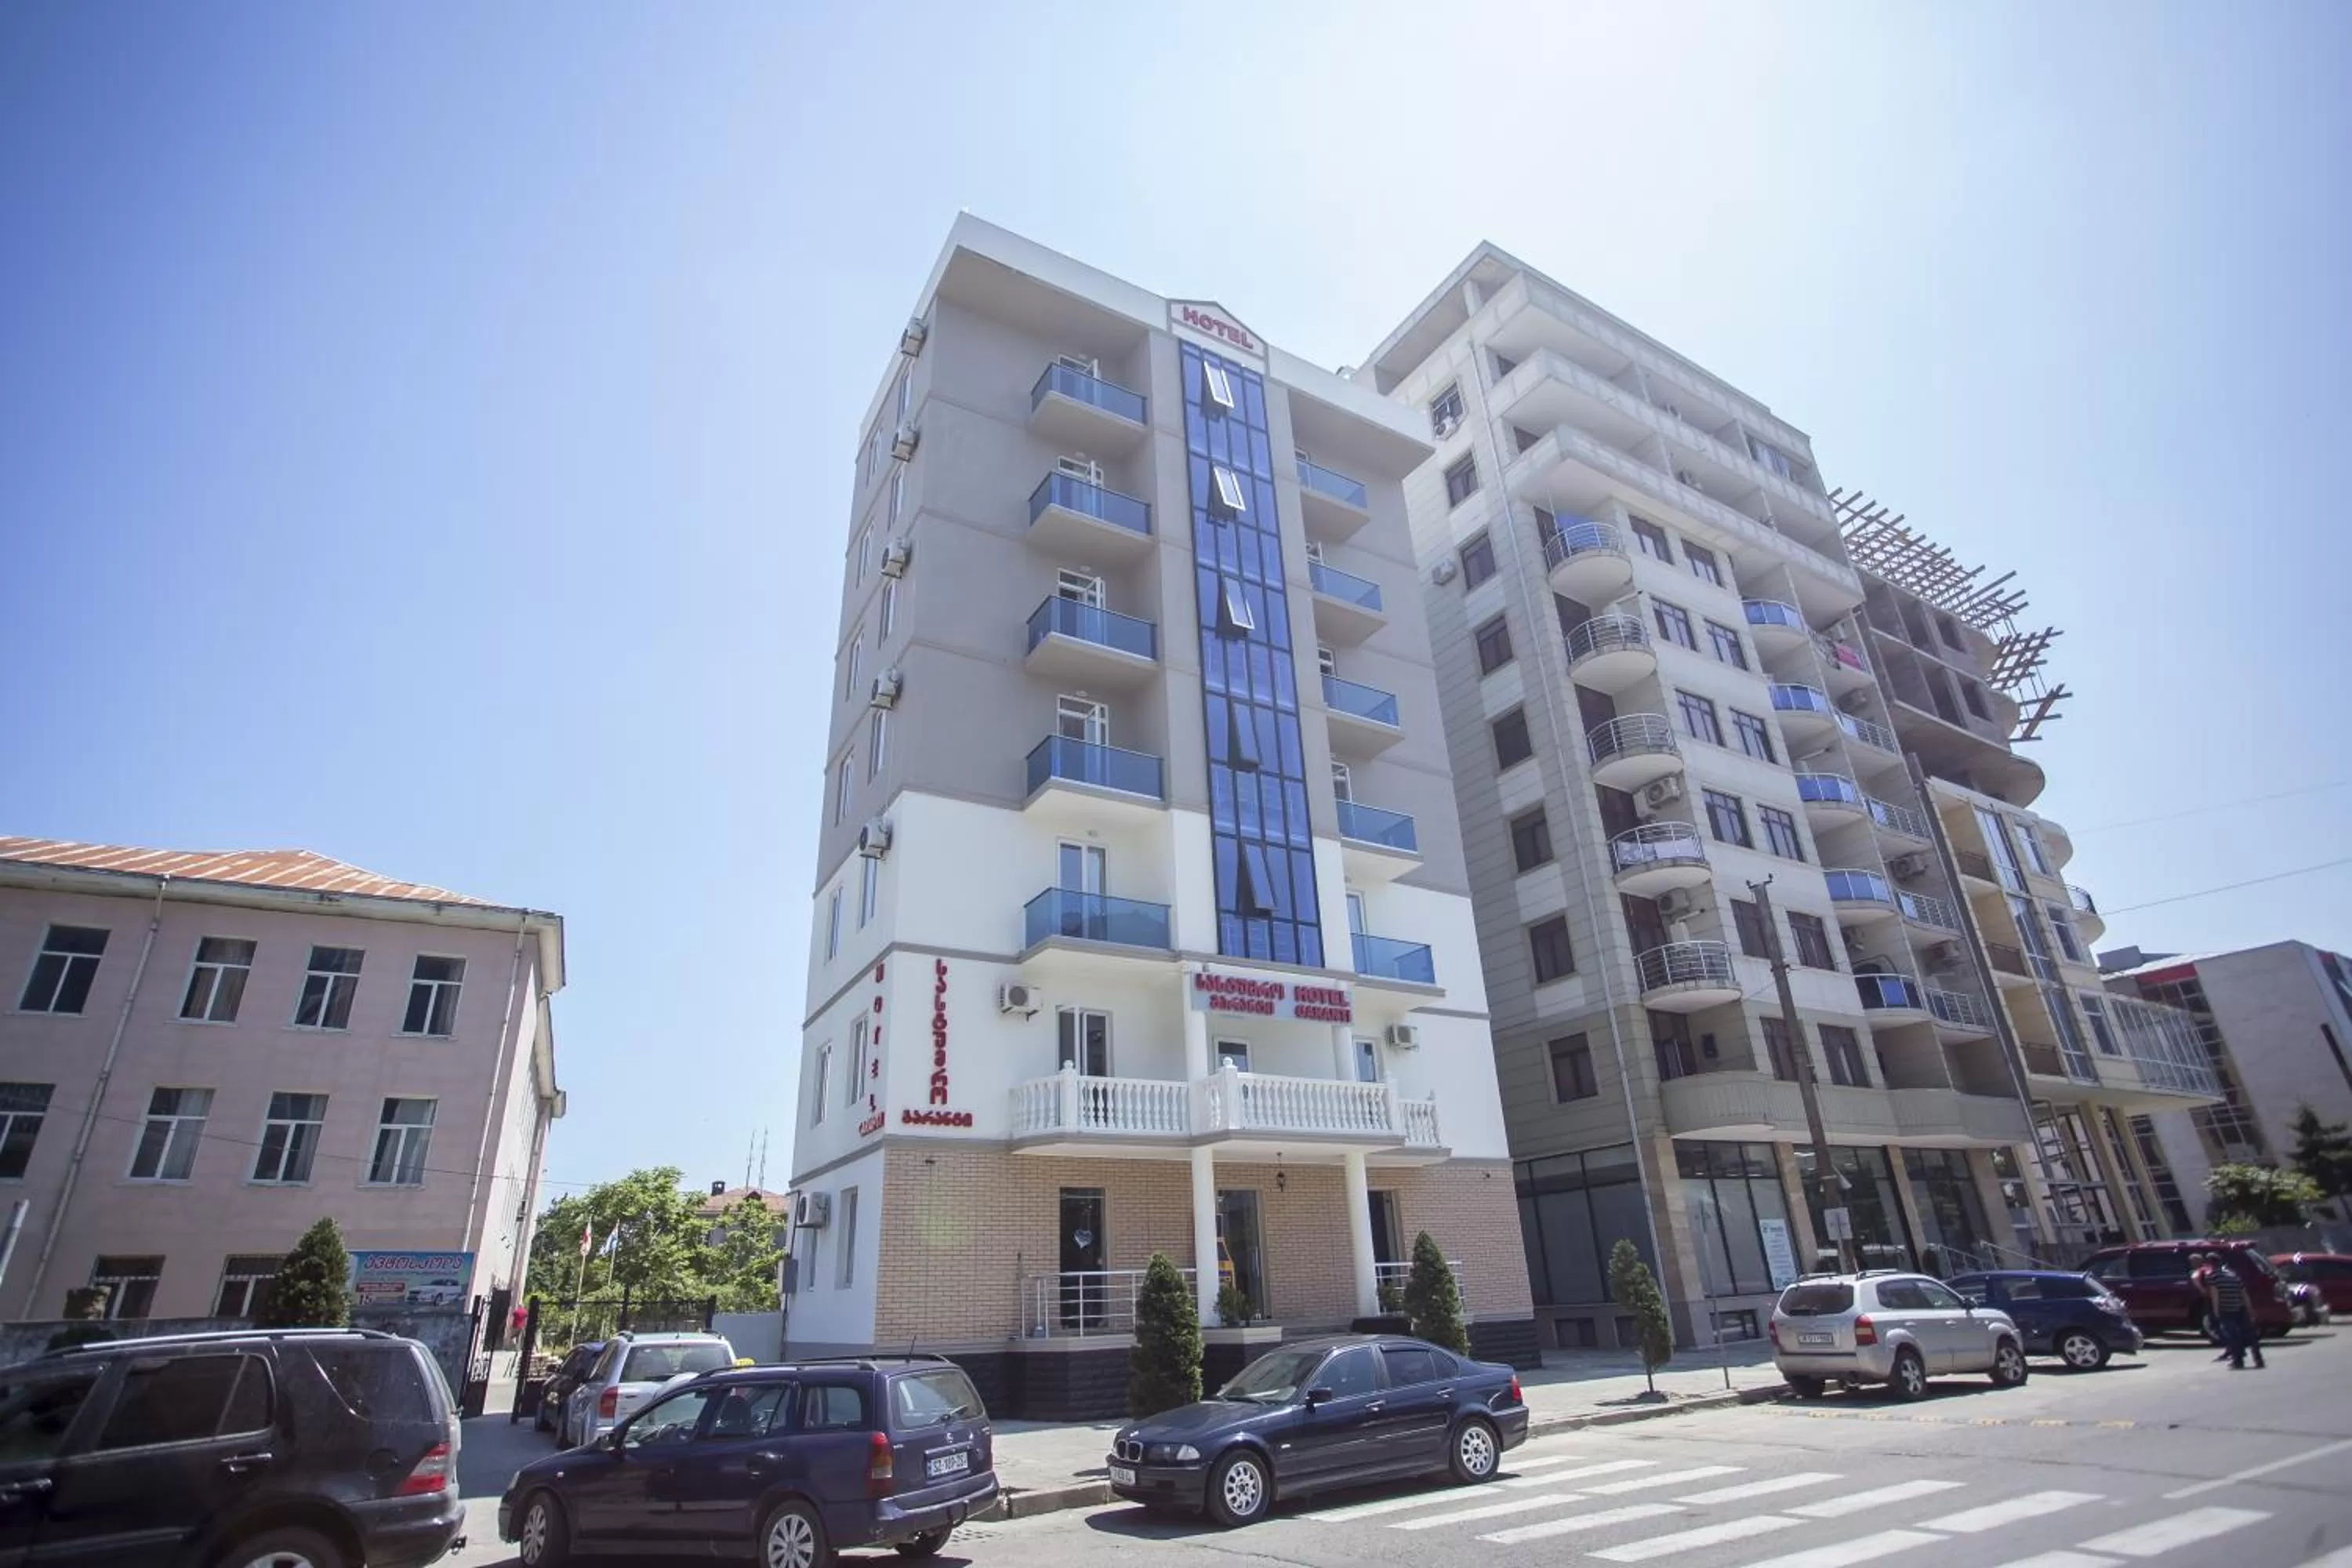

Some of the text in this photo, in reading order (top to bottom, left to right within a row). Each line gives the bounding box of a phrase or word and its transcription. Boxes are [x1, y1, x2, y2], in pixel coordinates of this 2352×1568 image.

[1183, 306, 1254, 350] HOTEL
[1196, 973, 1284, 1000] სასტუმრო
[1294, 985, 1349, 1007] HOTEL
[931, 958, 947, 1105] სასტუმრო
